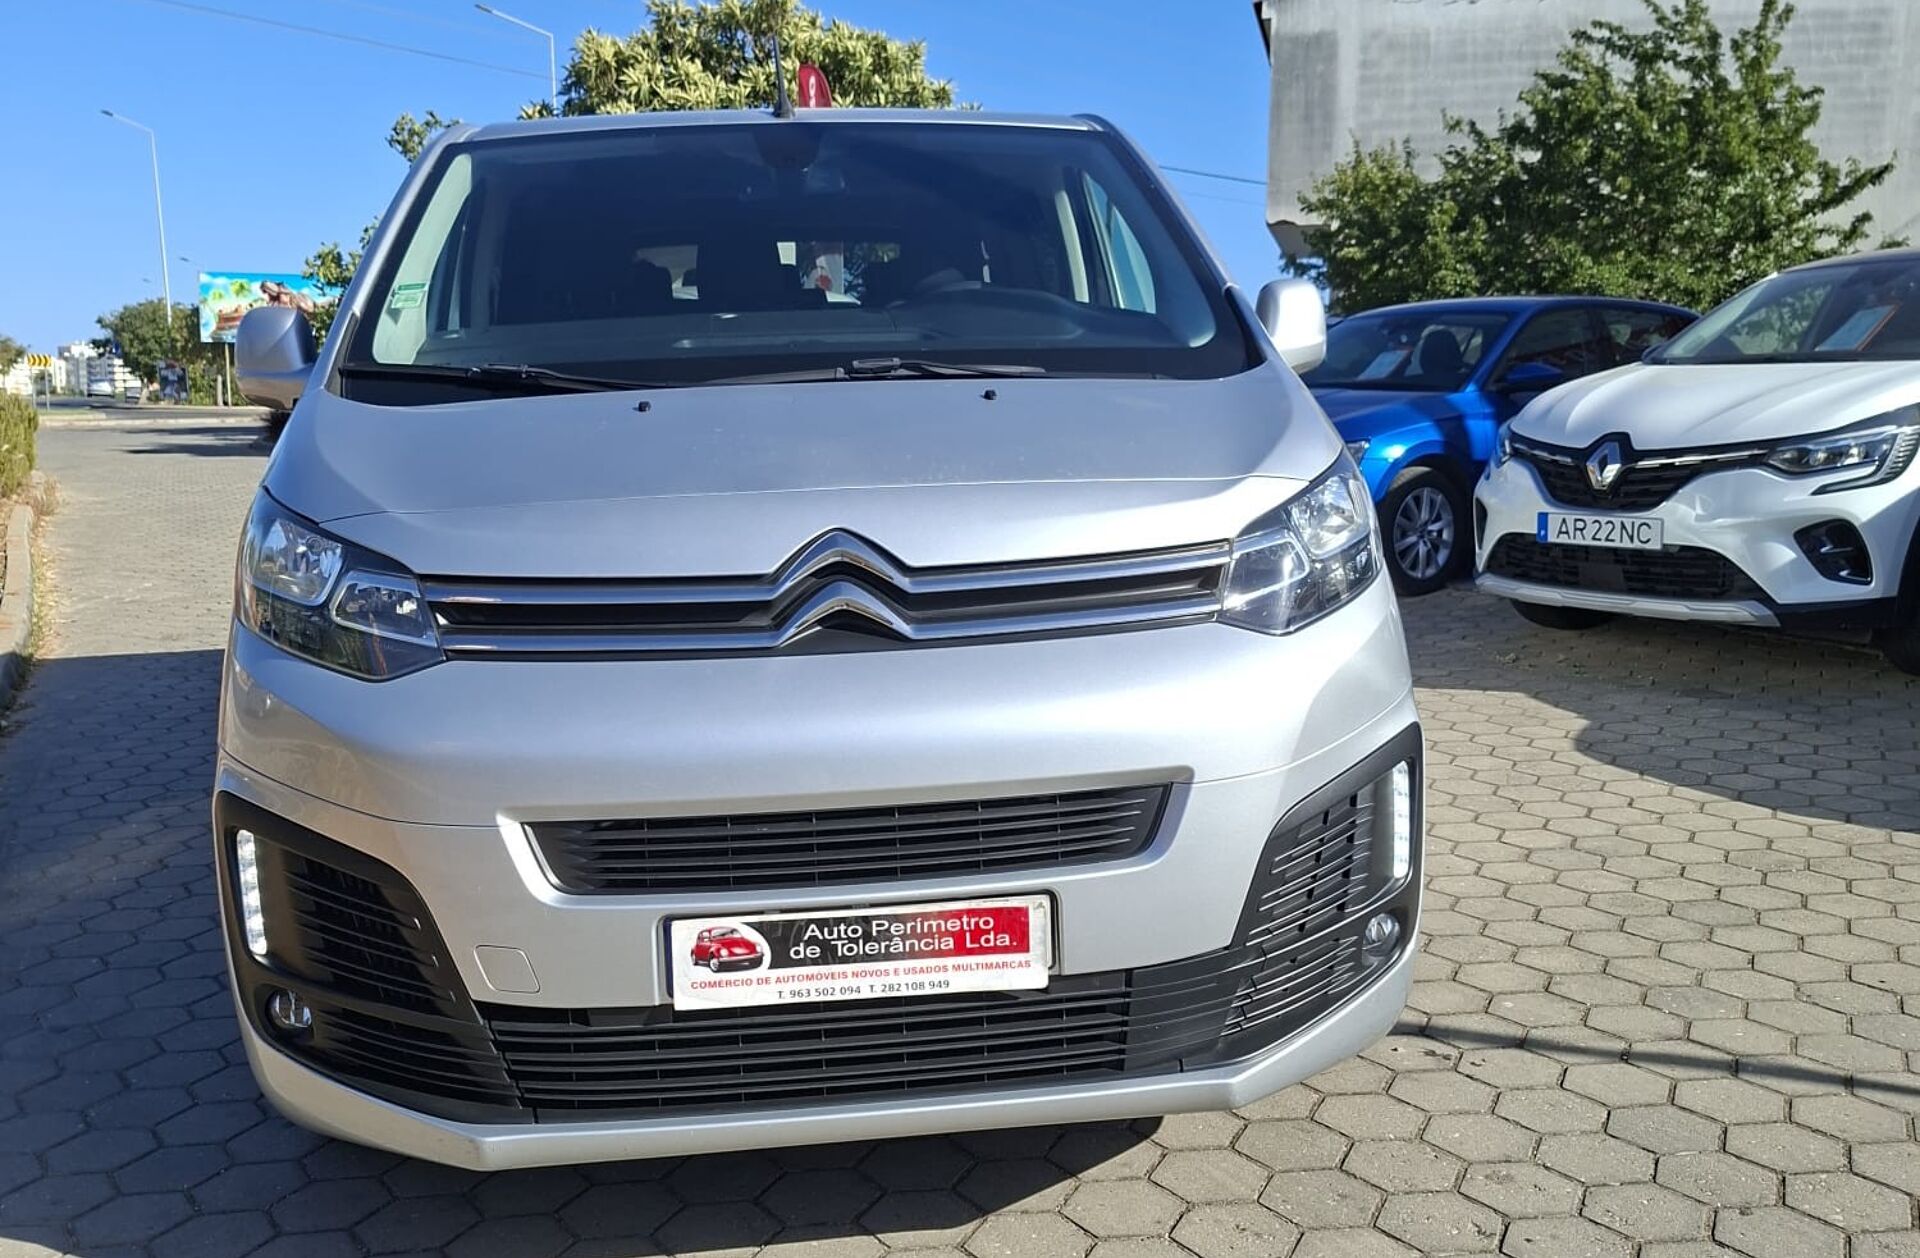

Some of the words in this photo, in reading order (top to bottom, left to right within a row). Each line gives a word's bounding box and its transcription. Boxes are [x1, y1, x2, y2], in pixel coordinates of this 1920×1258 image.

[803, 923, 862, 941] Auto
[872, 915, 994, 937] Perímetro
[789, 943, 821, 959] de
[831, 937, 955, 957] Tolerância
[965, 931, 1018, 949] Lda.
[757, 976, 771, 986] DE
[851, 968, 890, 979] NOVOS
[893, 966, 900, 976] E
[903, 963, 949, 975] USADOS
[952, 960, 1032, 972] MULTIMARCAS
[778, 990, 786, 999] T.
[789, 989, 811, 999] 963
[815, 986, 836, 996] 502
[840, 985, 862, 995] 094
[869, 985, 877, 993] T.
[881, 982, 902, 992] 282
[905, 980, 926, 991] 108
[928, 979, 950, 989] 949
